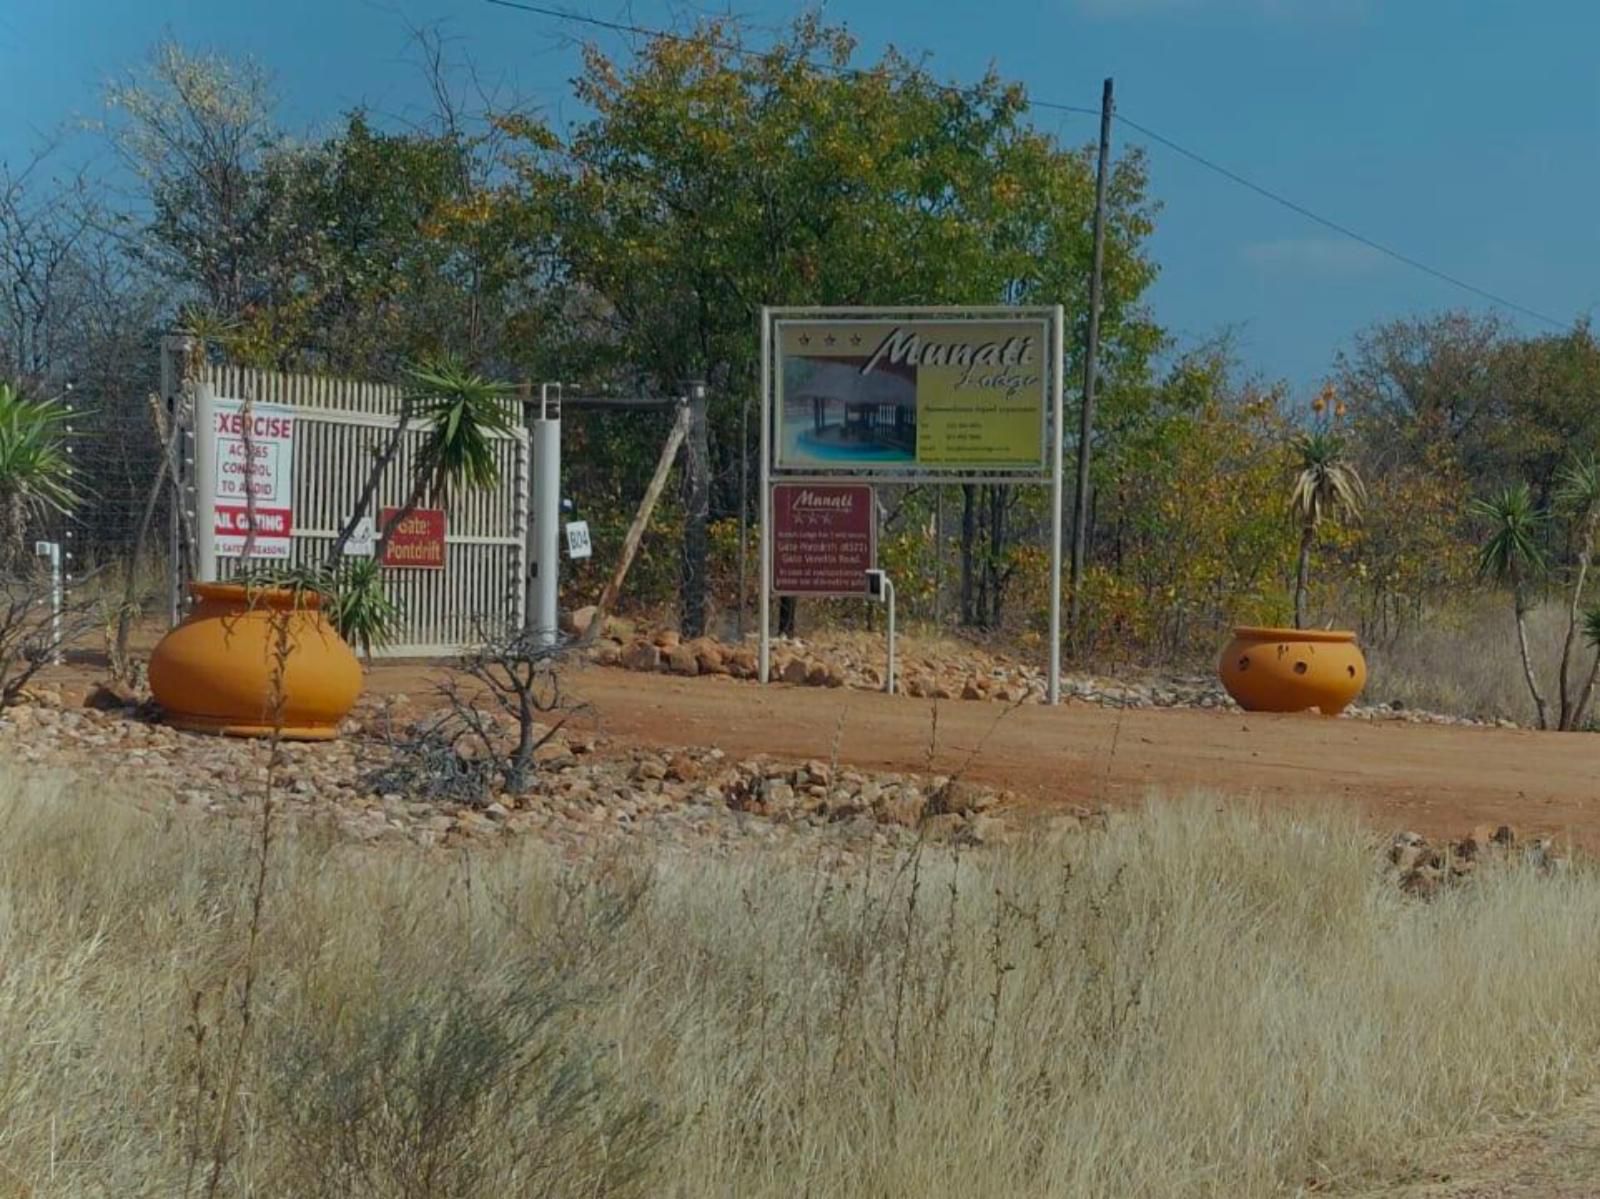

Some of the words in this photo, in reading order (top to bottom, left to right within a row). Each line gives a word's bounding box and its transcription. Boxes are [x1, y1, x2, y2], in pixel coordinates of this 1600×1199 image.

[859, 327, 1035, 376] Munati
[954, 366, 1038, 400] Lodge
[213, 412, 291, 439] XECISE
[229, 444, 269, 459] ACSS
[222, 461, 272, 477] CONROL
[222, 480, 236, 493] TO
[239, 482, 272, 496] AOID
[387, 540, 441, 561] Pontdrift
